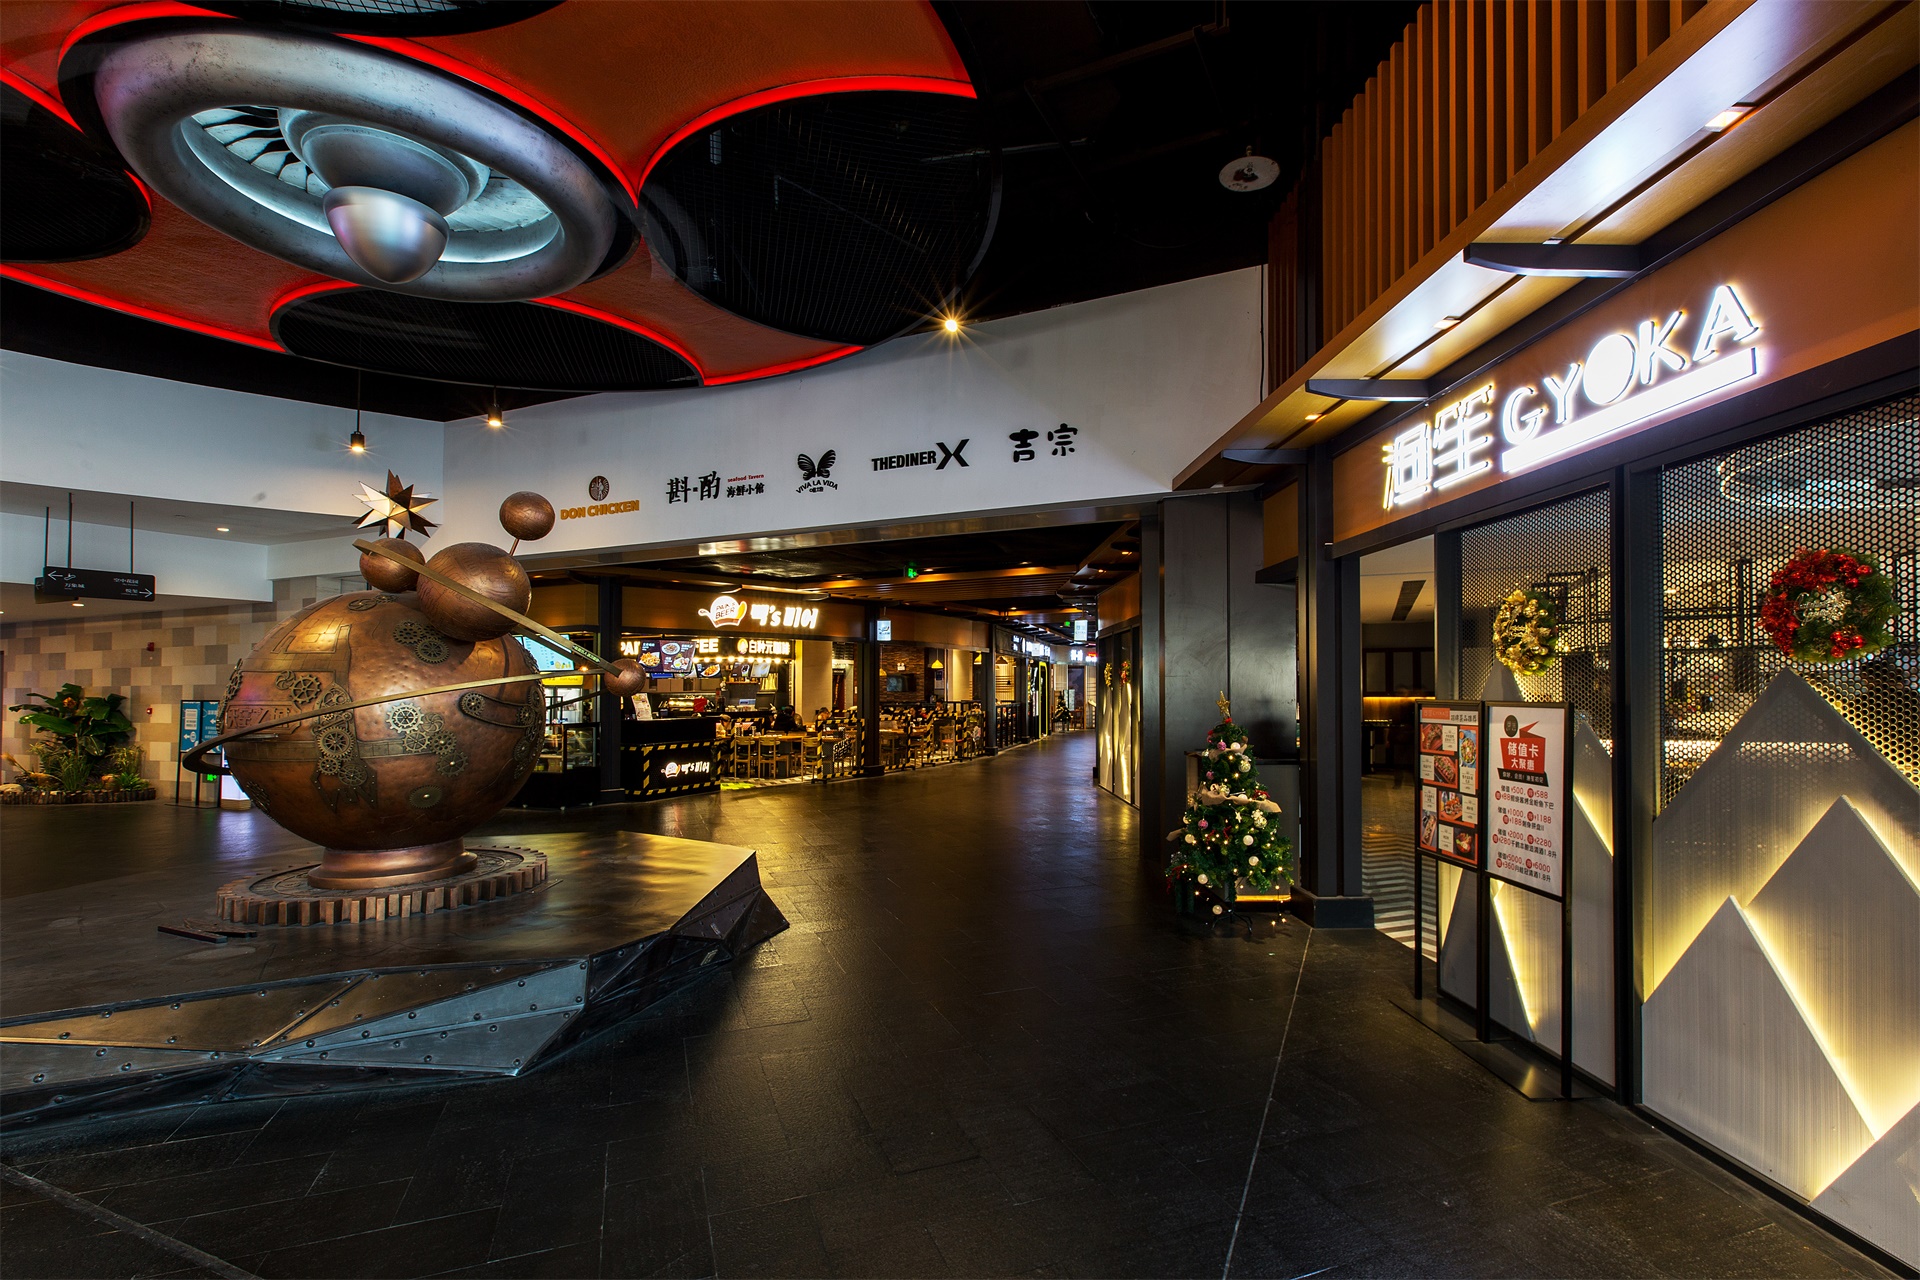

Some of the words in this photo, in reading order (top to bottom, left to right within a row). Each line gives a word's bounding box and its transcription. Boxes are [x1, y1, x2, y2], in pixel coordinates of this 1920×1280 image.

[1502, 284, 1760, 445] GYOKA
[1009, 423, 1078, 463] 吉宗
[796, 482, 811, 494] VIVA
[823, 480, 838, 490] VIDA
[560, 507, 586, 520] DON
[587, 500, 639, 517] CHICKEN
[1507, 741, 1539, 758] 储值卡
